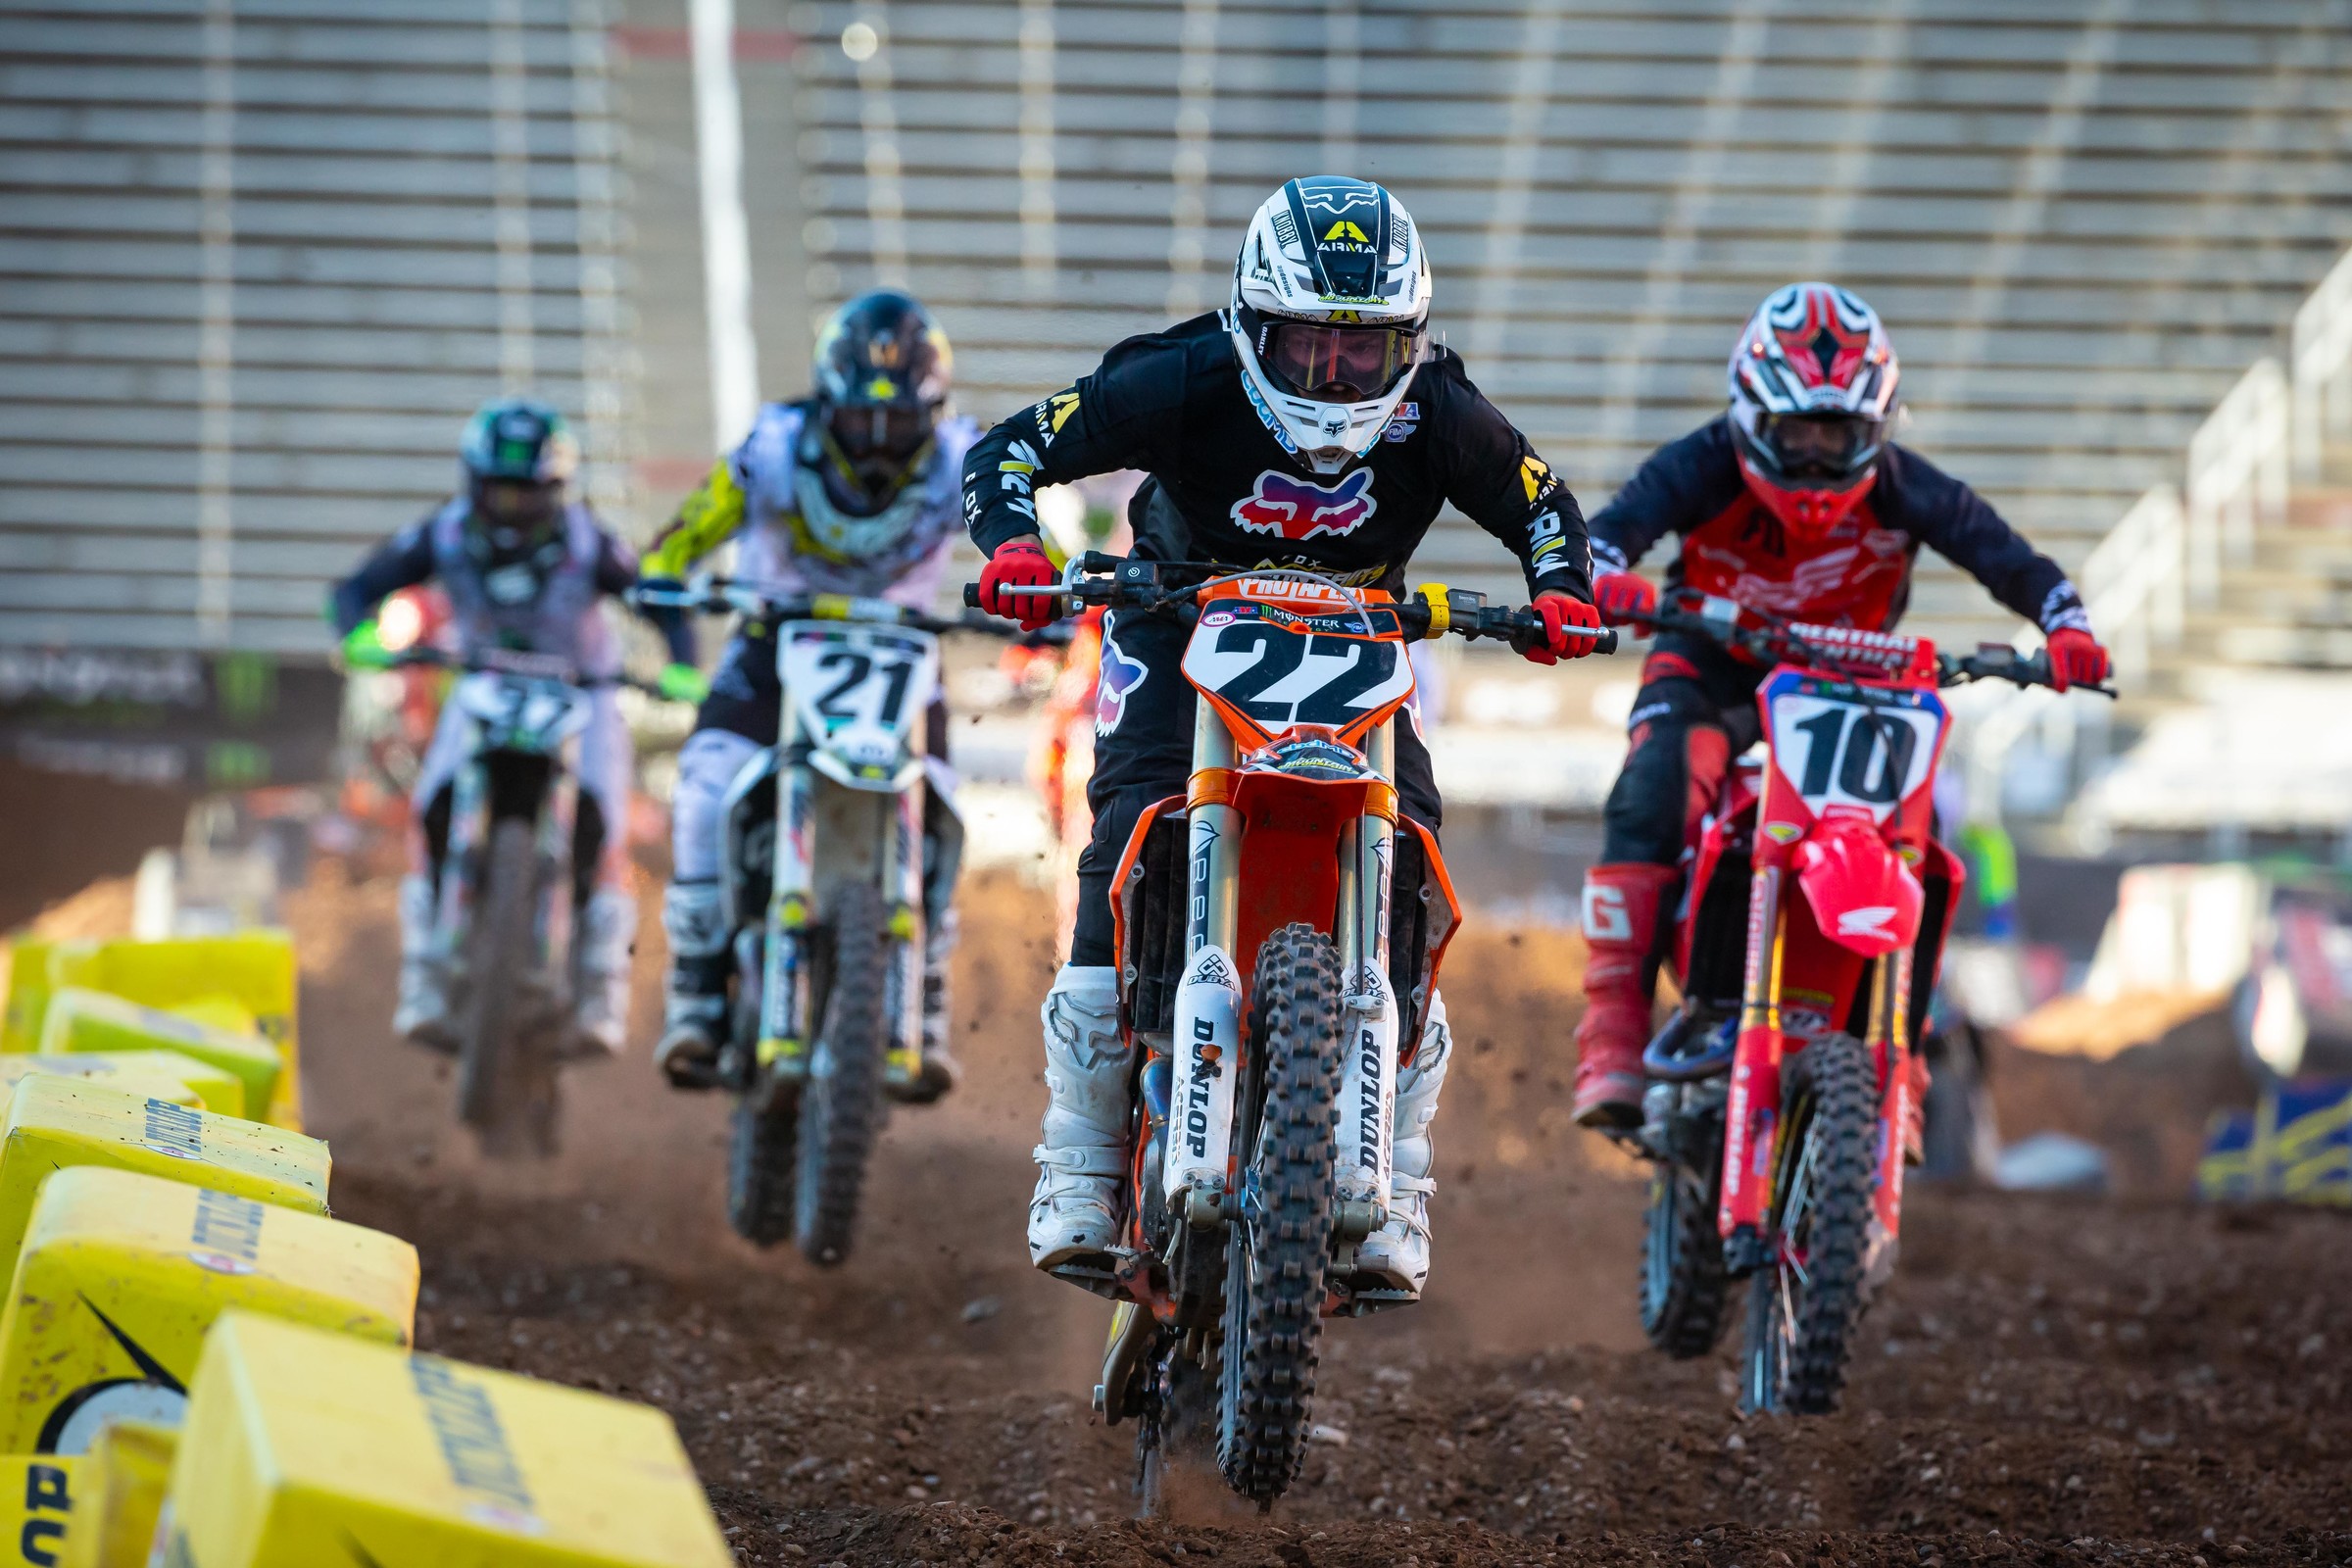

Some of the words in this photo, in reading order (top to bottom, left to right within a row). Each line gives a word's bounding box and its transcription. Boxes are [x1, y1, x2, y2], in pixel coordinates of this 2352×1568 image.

[1271, 209, 1298, 250] KNOBBY
[1316, 243, 1377, 254] ARMA
[1392, 213, 1408, 254] KNOBBY
[1277, 309, 1319, 322] ARMA
[1257, 325, 1268, 356] OAKLEY
[1274, 611, 1340, 628] MONSTER
[815, 653, 912, 731] 21
[1214, 623, 1396, 724] 22
[1794, 709, 1916, 804] 10
[1360, 1029, 1381, 1175] DUNLOP
[1382, 1090, 1393, 1181] ACERBIS
